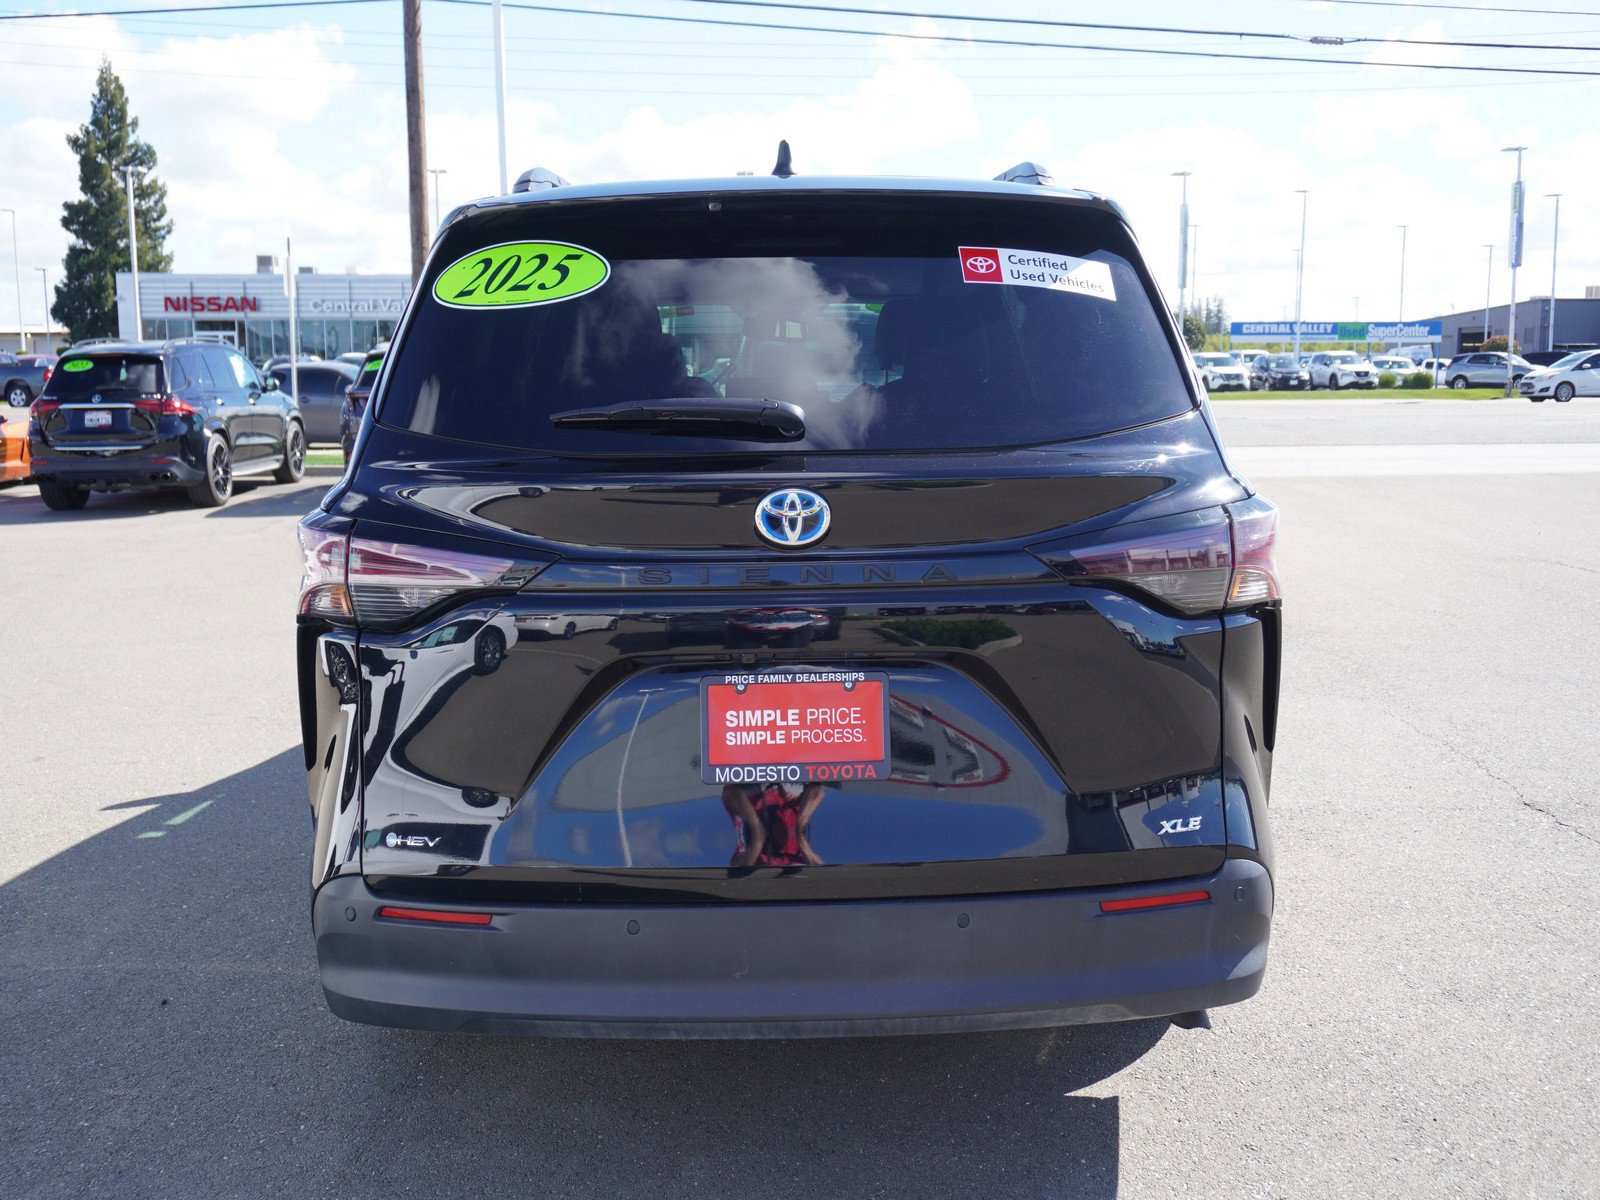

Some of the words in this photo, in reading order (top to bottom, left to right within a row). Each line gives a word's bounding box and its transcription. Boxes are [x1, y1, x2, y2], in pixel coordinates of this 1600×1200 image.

[1008, 254, 1068, 271] Certified
[453, 253, 584, 299] 2025
[1010, 270, 1045, 283] Used
[1050, 273, 1104, 292] Vehicles
[163, 296, 257, 312] NISSAN
[309, 299, 373, 312] Central
[1242, 323, 1291, 333] CENTRAL
[1340, 325, 1364, 337] Used
[1368, 323, 1430, 339] SuperCenter
[639, 563, 957, 585] SIENNA
[725, 675, 755, 684] PRICE
[757, 674, 793, 683] FAMILY
[796, 672, 865, 682] DEALERSHIPS
[725, 709, 800, 727] SIMPLE
[806, 707, 866, 725] PRICE.
[725, 730, 786, 746] SIMPLE
[791, 729, 867, 744] PROCESS.
[715, 766, 800, 782] MODESTO
[805, 764, 877, 780] TOYOTA
[1157, 816, 1202, 835] XLE
[397, 835, 442, 847] HEV
